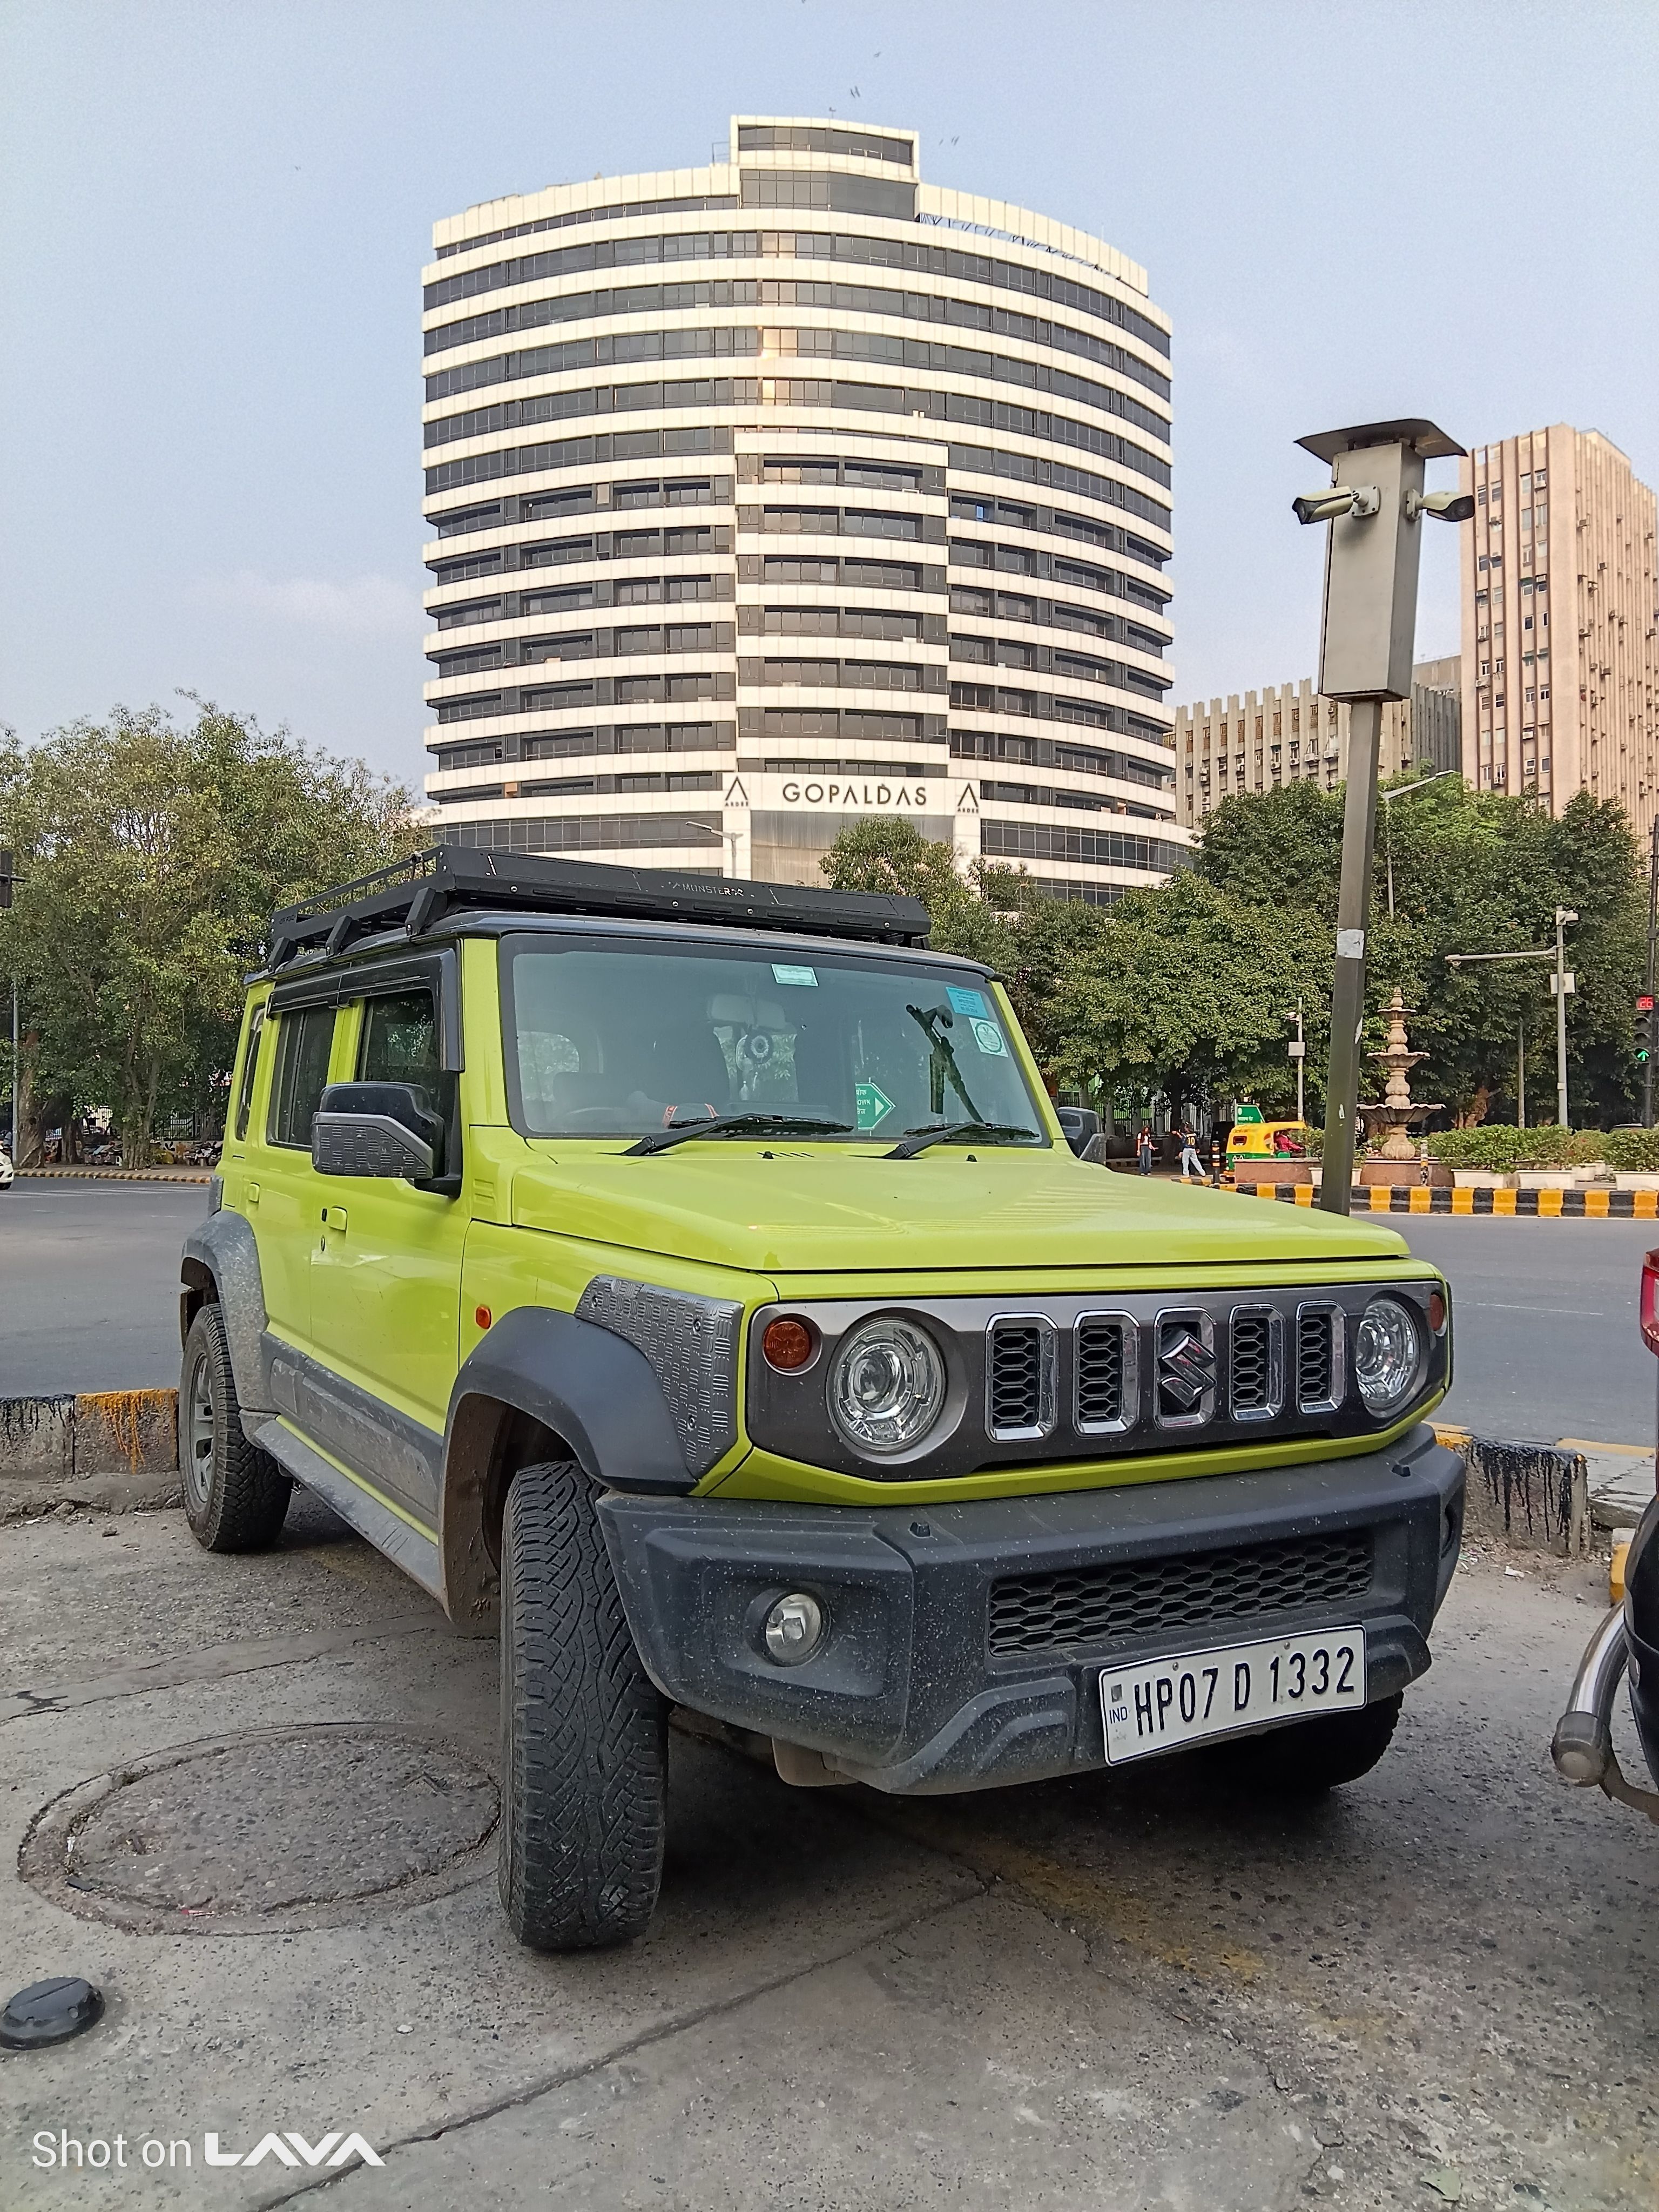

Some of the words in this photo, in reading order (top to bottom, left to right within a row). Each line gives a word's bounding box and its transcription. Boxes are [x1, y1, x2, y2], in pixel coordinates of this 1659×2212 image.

[783, 783, 927, 806] GOPALDAS
[1640, 997, 1654, 1008] 26
[1134, 1668, 1218, 1736] HP07
[1234, 1662, 1251, 1711] D
[1270, 1647, 1355, 1703] 1332
[1109, 1706, 1128, 1724] IND
